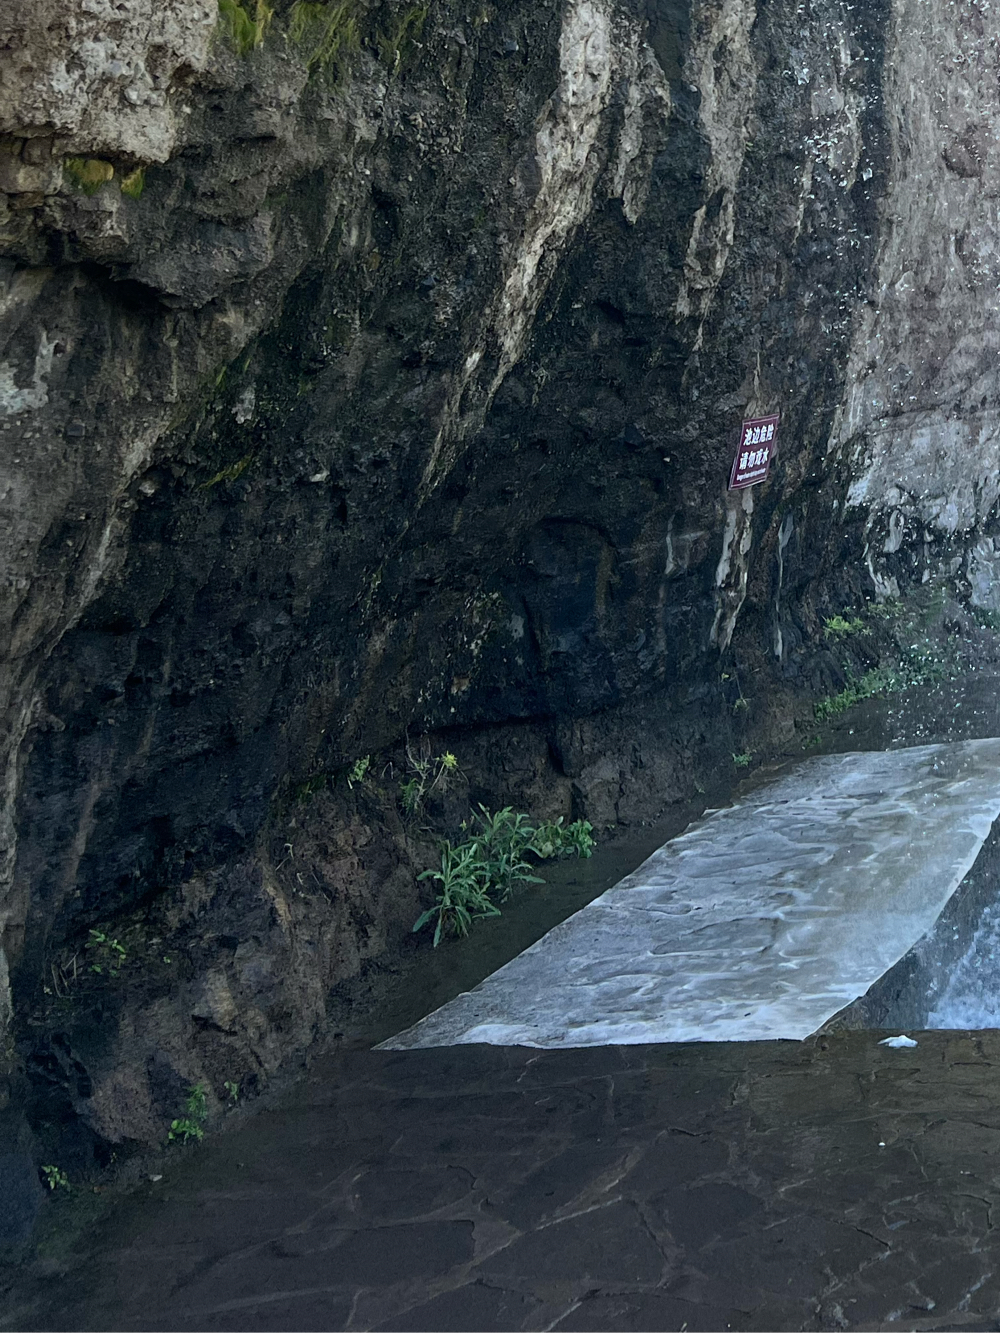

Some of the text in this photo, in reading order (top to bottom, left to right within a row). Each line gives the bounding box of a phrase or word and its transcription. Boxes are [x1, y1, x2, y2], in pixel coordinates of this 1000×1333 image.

[743, 423, 774, 446] 池边危险
[739, 447, 770, 470] 请勿戏水
